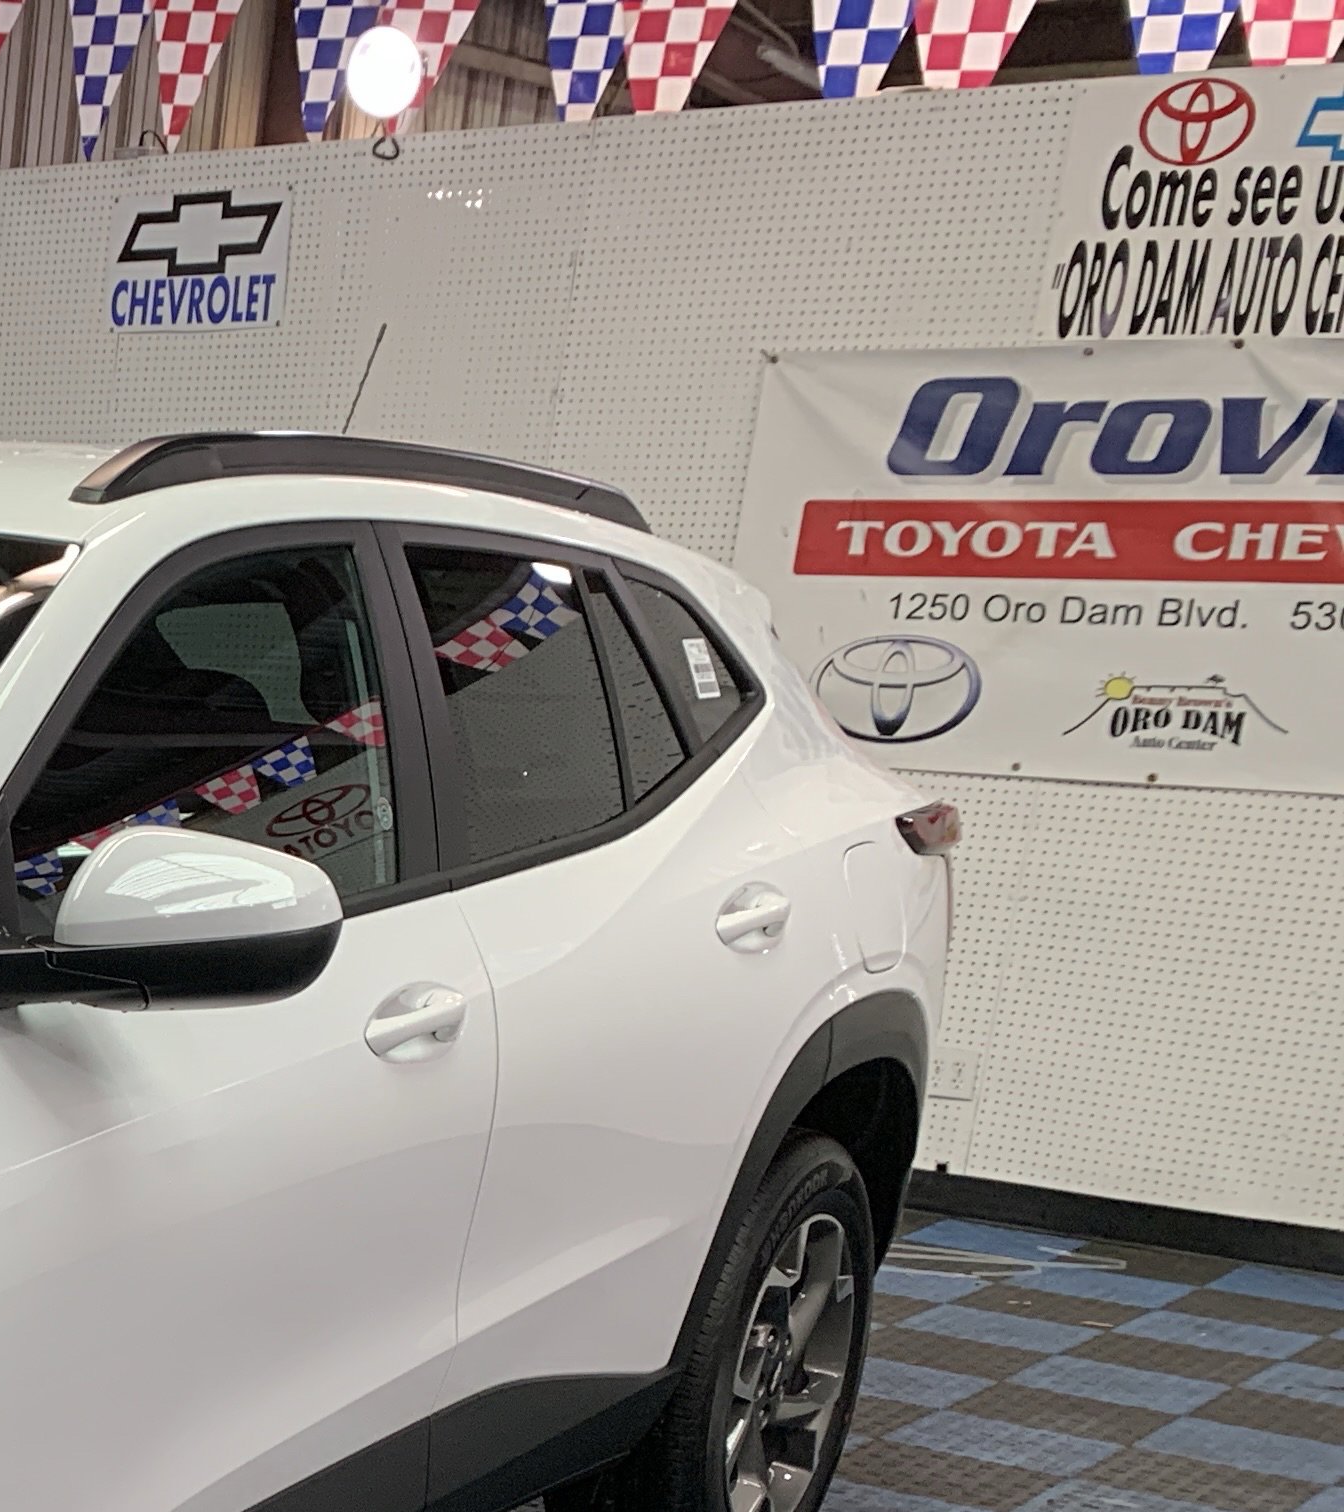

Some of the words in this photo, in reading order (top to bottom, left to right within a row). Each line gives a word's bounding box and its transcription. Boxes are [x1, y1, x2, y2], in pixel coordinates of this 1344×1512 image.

[1102, 145, 1218, 230] Come
[1227, 165, 1303, 227] see
[1315, 165, 1344, 225] u
[112, 274, 276, 327] CHEVROLET
[1050, 239, 1130, 341] "ORO
[1127, 237, 1213, 336] DAM
[1207, 233, 1304, 337] AUTO
[835, 520, 1116, 559] TOYOTA
[1173, 521, 1344, 562] CHE
[888, 592, 970, 622] 1250
[983, 594, 1046, 625] Oro
[1059, 595, 1143, 628] Dam
[1158, 598, 1249, 629] Blvd.
[1290, 600, 1344, 631] 53
[1109, 706, 1172, 738] ORO
[1180, 708, 1247, 746] DAM
